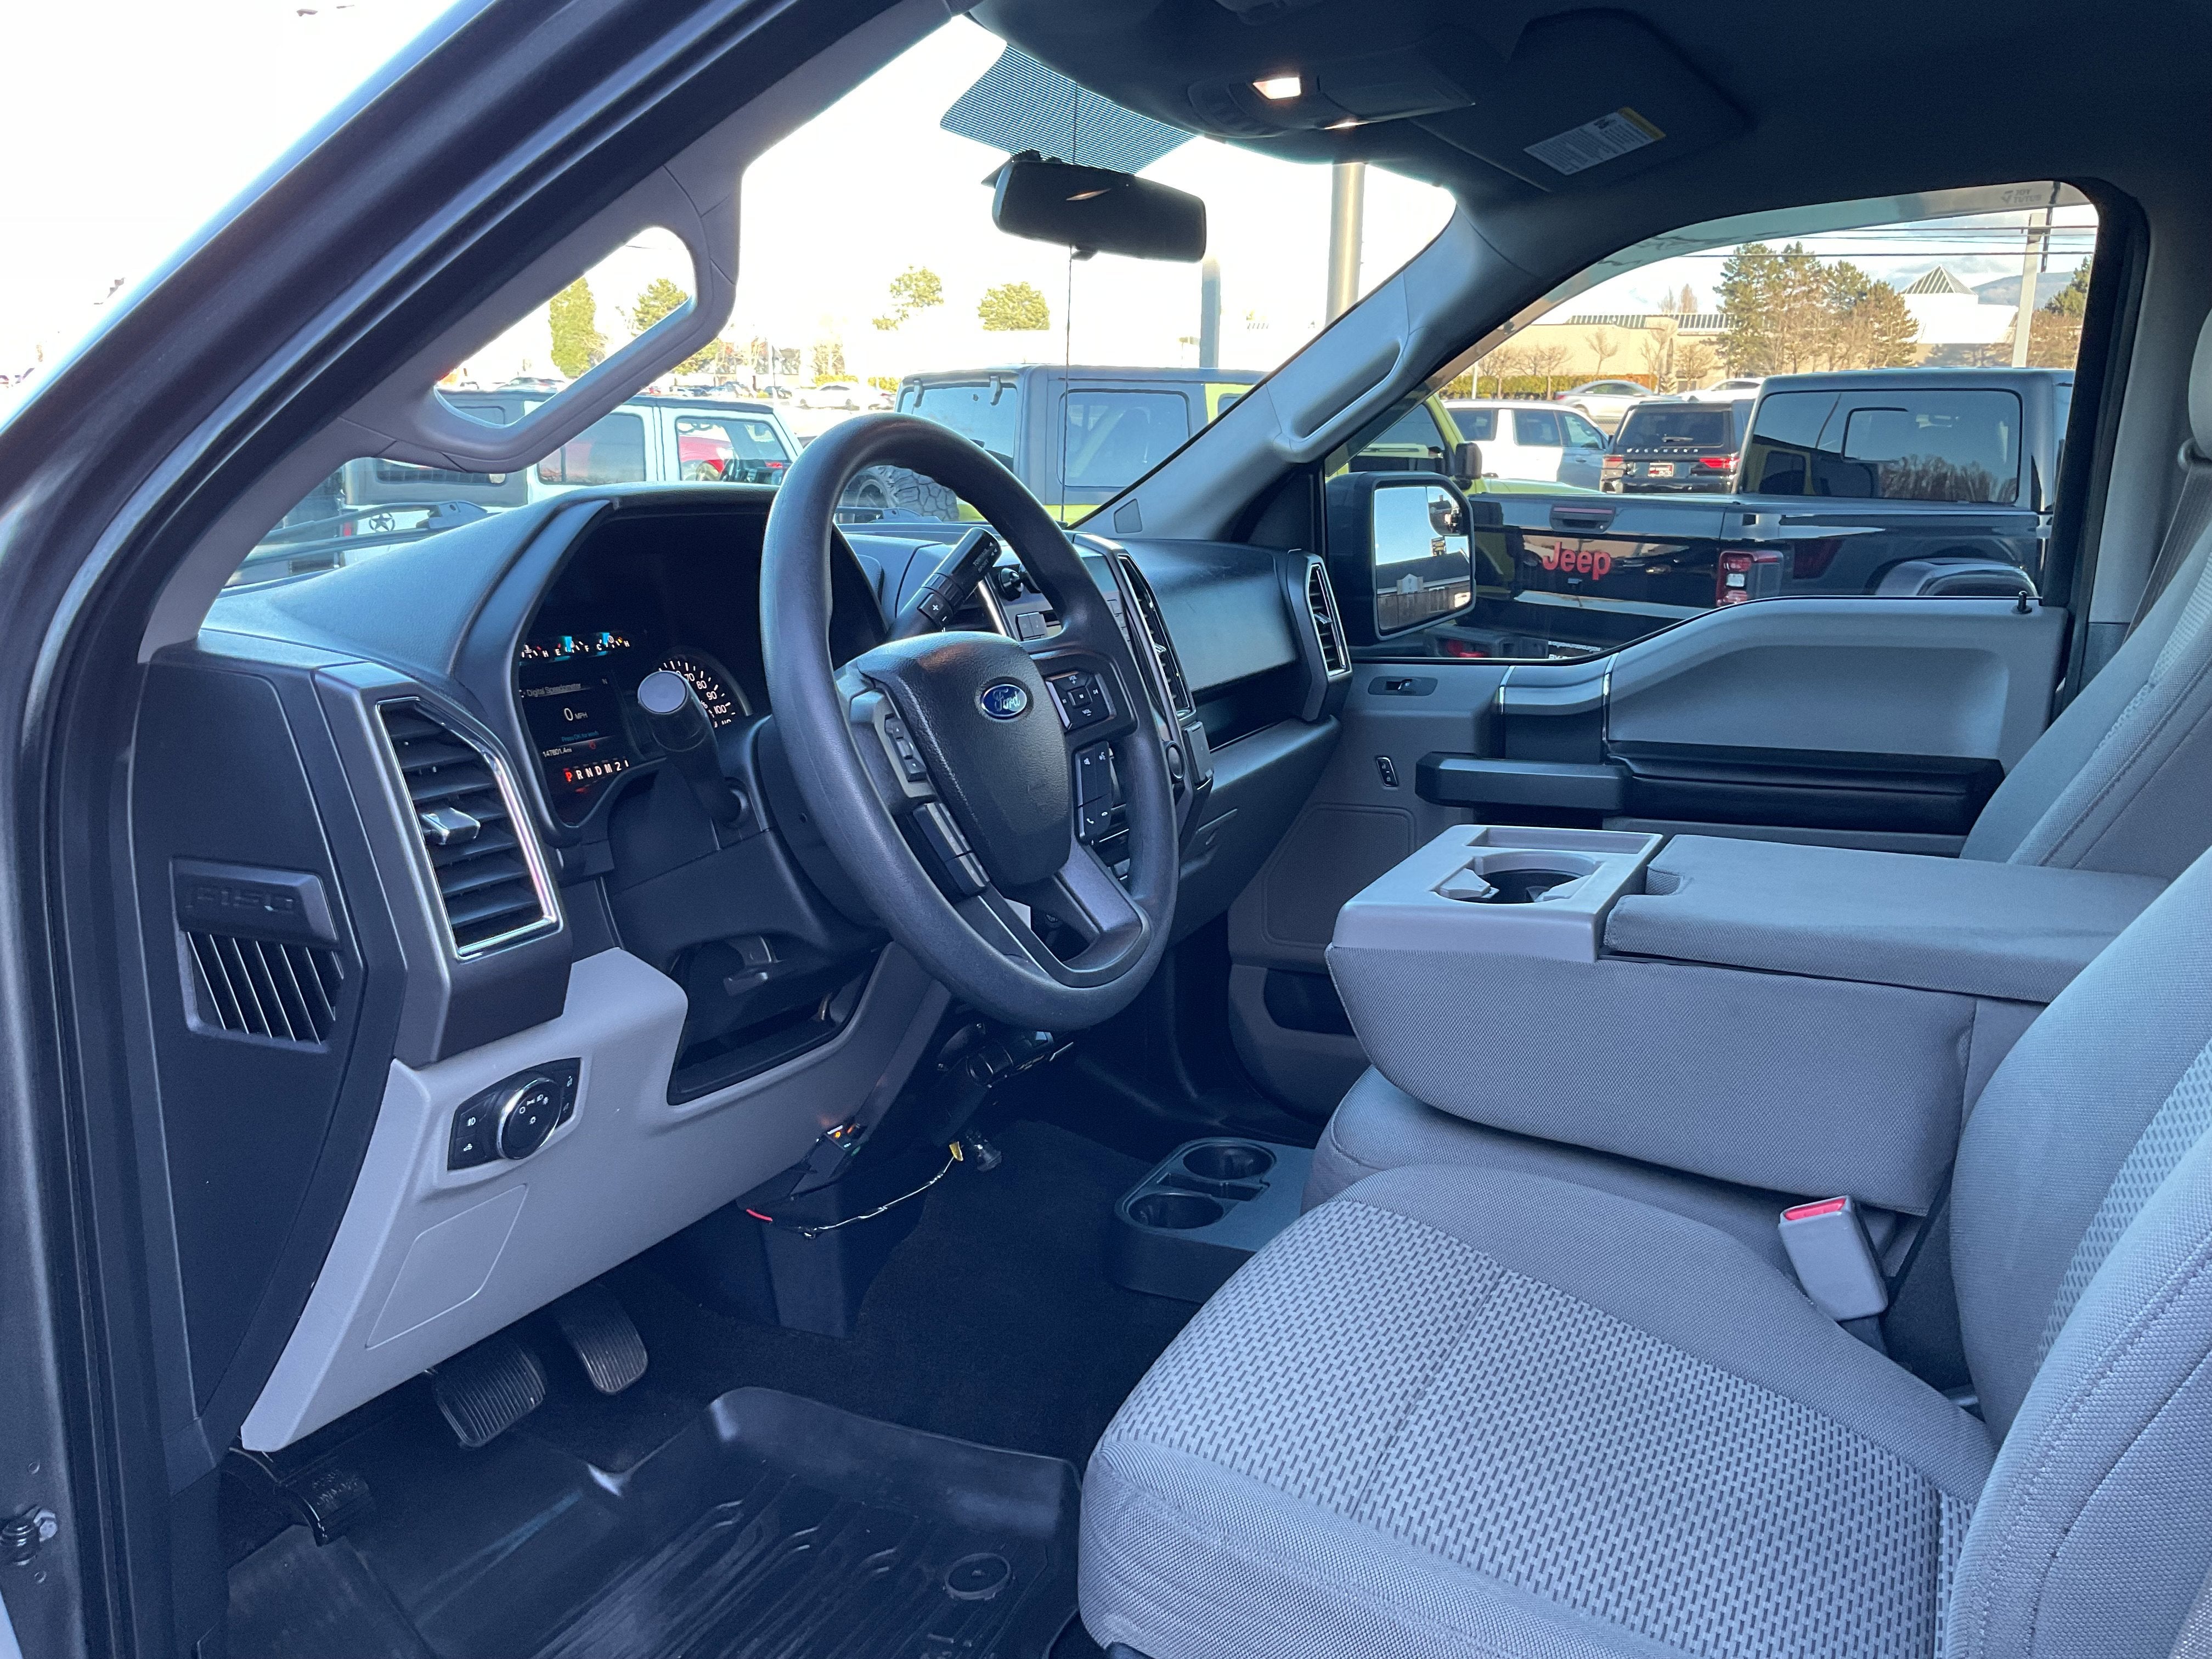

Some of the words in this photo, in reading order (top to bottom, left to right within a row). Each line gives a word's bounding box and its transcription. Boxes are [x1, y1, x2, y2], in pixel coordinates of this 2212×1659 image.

[1543, 541, 1611, 580] Jeep
[684, 673, 695, 681] 70
[696, 680, 707, 690] 80
[526, 688, 545, 697] Digital
[706, 691, 718, 701] 90
[992, 687, 1021, 712] Ford
[714, 704, 727, 714] 100
[564, 708, 573, 721] 0
[565, 771, 572, 782] P
[575, 770, 583, 780] R
[585, 768, 593, 778] N
[594, 765, 602, 776] D
[604, 763, 613, 774] M
[614, 761, 622, 771] 2
